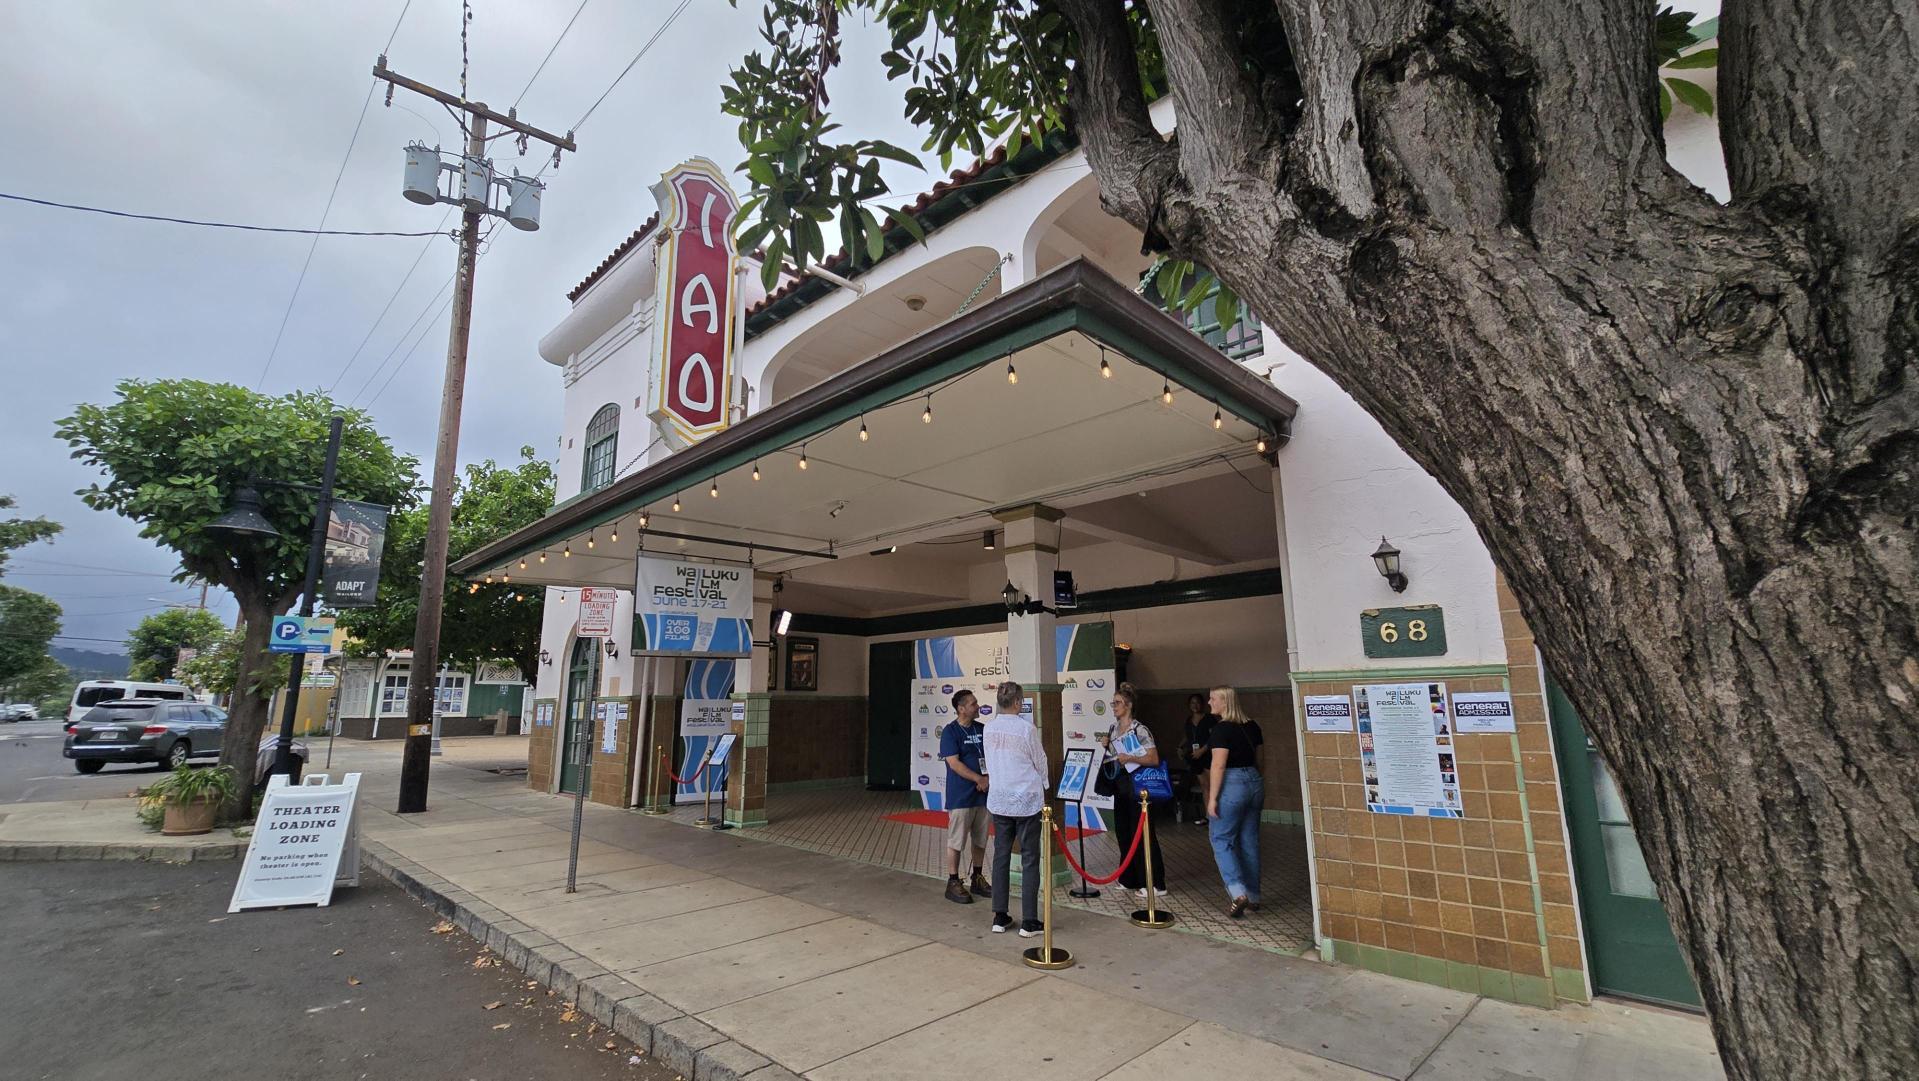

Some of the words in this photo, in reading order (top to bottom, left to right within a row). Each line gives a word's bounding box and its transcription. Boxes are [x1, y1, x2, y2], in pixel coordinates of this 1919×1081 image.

[678, 191, 718, 413] IAO
[335, 580, 366, 591] ADAPT
[582, 590, 591, 600] 15
[592, 592, 614, 600] MINUTE
[691, 598, 727, 609] 17-21
[281, 624, 296, 638] P
[665, 625, 690, 635] 100
[1380, 619, 1428, 643] 68
[273, 805, 341, 816] THEATER
[269, 819, 336, 831] LOADING
[279, 834, 320, 845] ZONE
[273, 853, 306, 862] parking
